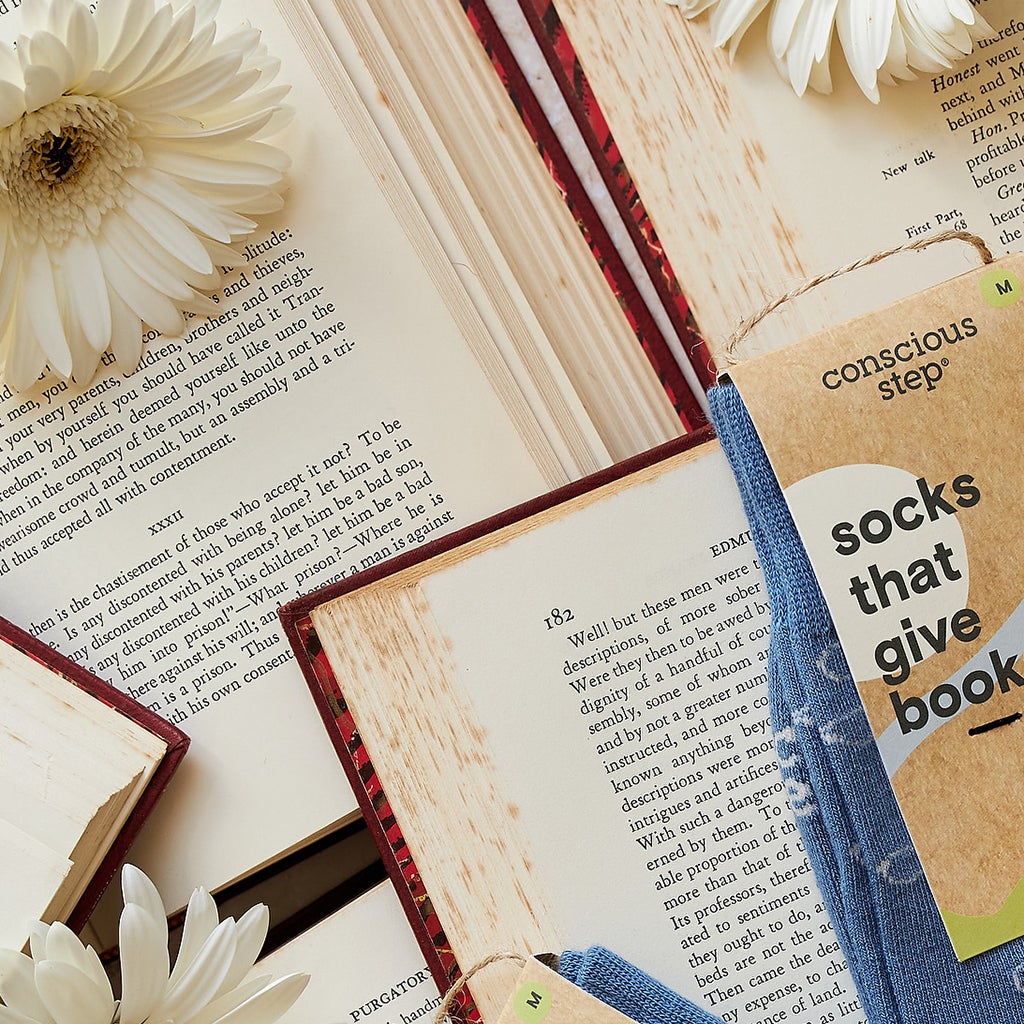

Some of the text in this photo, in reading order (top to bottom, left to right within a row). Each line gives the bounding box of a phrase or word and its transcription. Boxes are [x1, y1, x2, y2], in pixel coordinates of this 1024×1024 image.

[945, 98, 996, 131] behind
[970, 123, 1007, 144] Hon.
[881, 149, 935, 180] New talk
[904, 209, 963, 239] First Part,
[954, 219, 967, 231] 68
[995, 279, 1013, 295] M
[821, 317, 978, 390] conscious
[0, 286, 324, 475] when by yourself you should have called it Tran-
[147, 509, 184, 536] XXXII
[831, 473, 981, 556] socks
[62, 438, 412, 641] Is any discontented with being alone? let him be in
[848, 541, 962, 615] that
[543, 607, 575, 630] 182
[566, 565, 750, 648] Well! but these men were
[563, 582, 761, 676] descriptions, of more sober
[874, 608, 982, 686] give
[525, 990, 542, 1009] M
